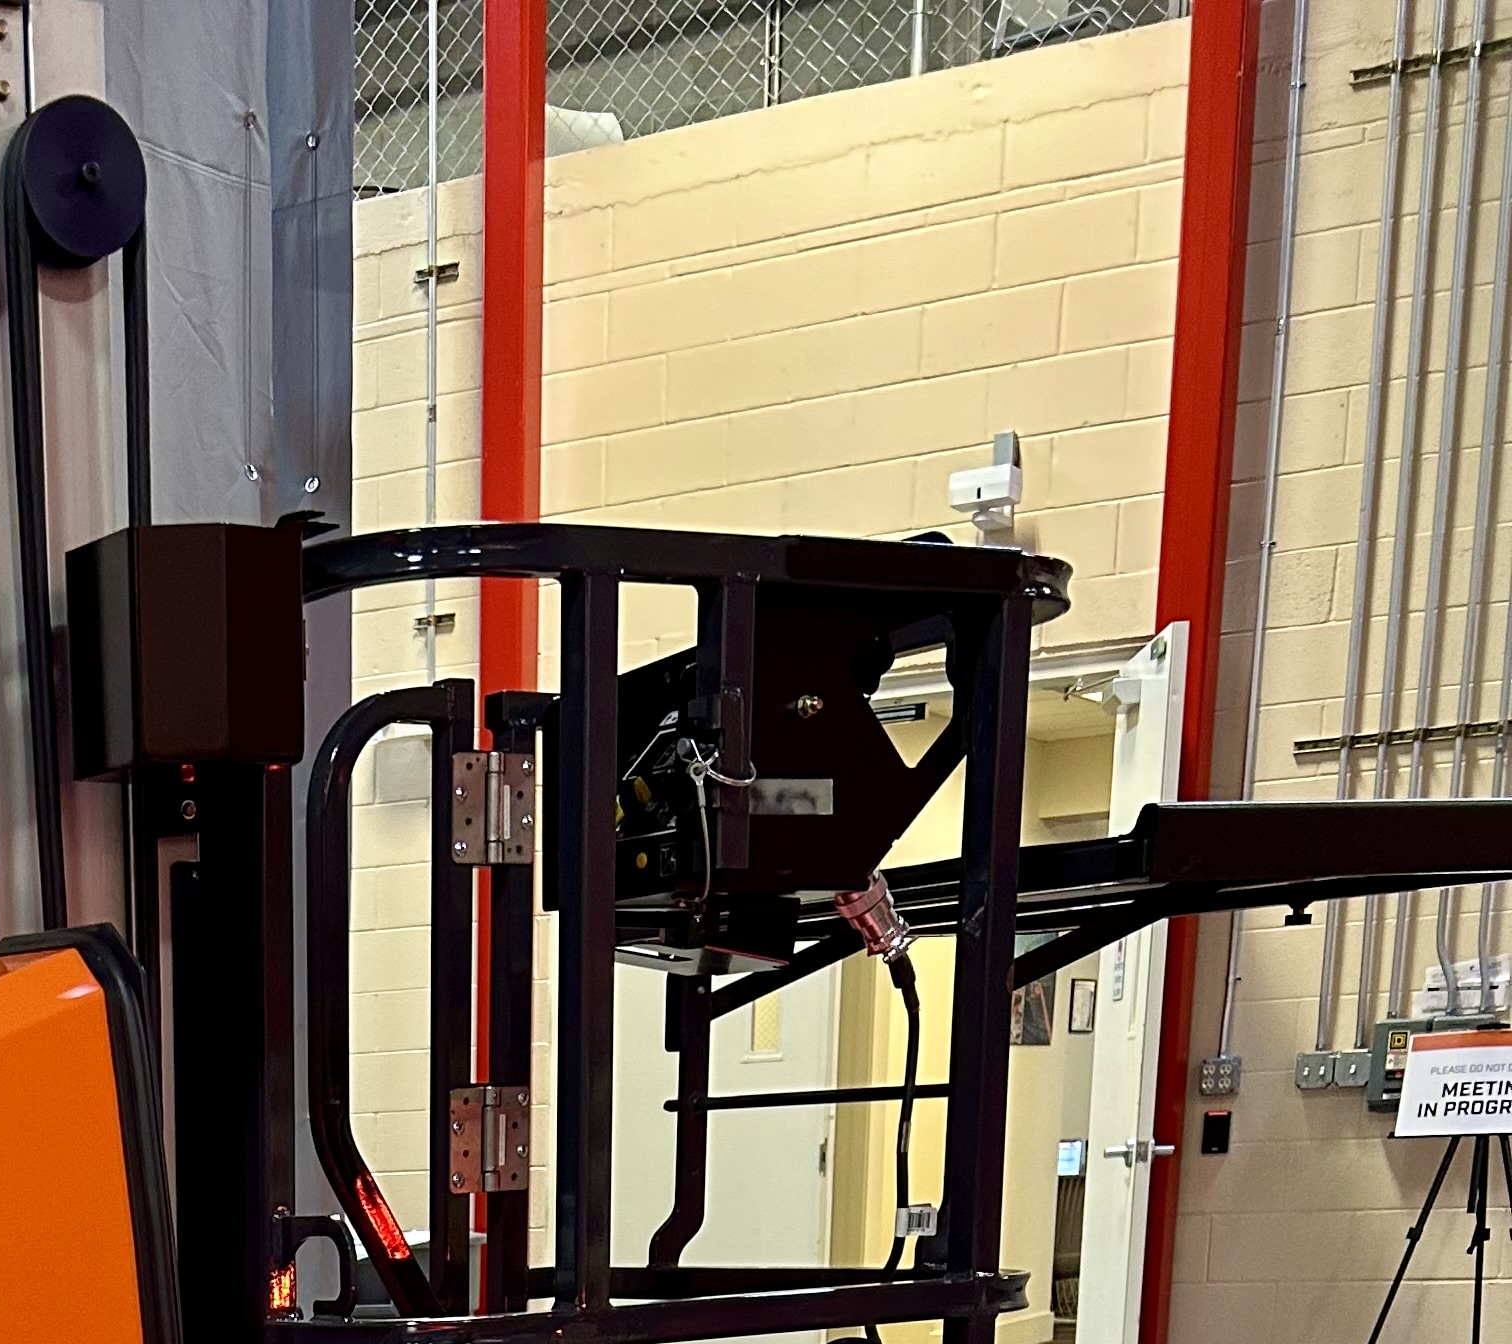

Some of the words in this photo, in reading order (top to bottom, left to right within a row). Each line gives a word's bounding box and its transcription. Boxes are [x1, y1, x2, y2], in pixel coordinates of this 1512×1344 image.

[1430, 1064, 1467, 1075] PLEASE
[1469, 1064, 1484, 1074] DO
[1485, 1063, 1505, 1073] NOT
[1417, 1102, 1438, 1118] IN
